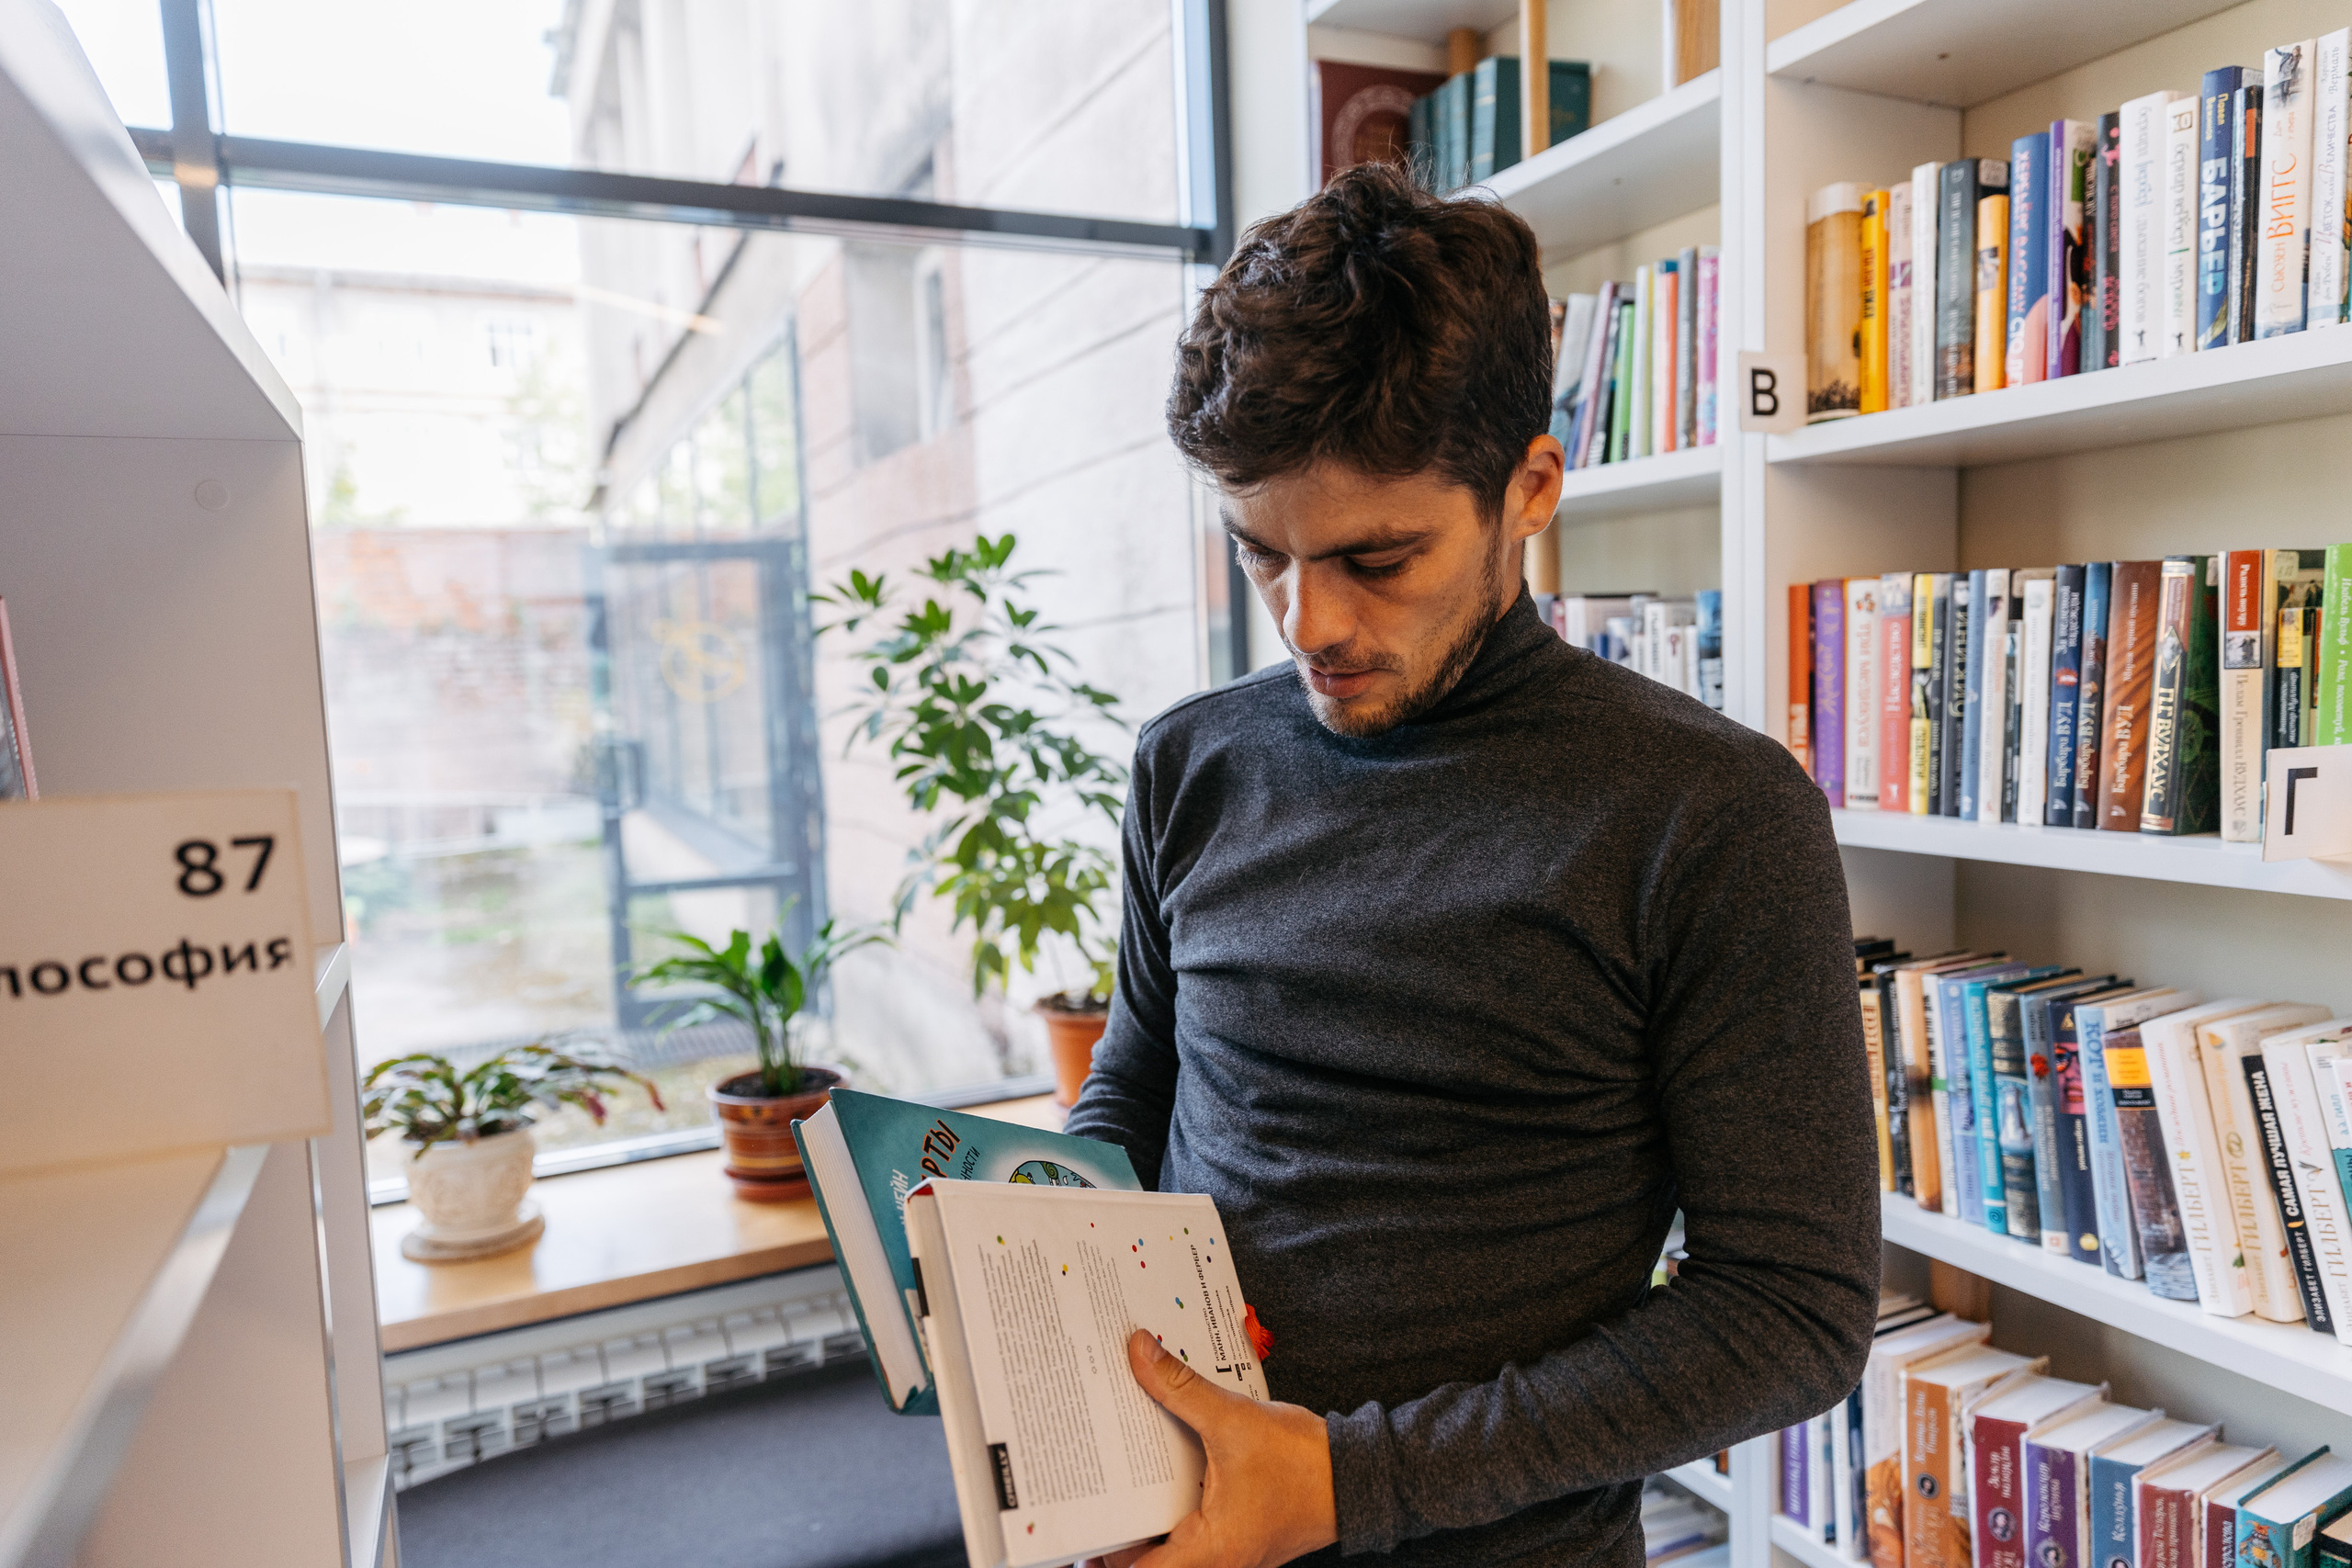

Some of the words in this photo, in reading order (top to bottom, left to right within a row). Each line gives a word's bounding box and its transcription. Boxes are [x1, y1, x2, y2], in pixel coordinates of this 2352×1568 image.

[2216, 94, 2228, 126] Павел
[2266, 152, 2297, 241] ВИГГС
[2199, 158, 2228, 296] БАРЬЕР
[2009, 317, 2026, 357] СТО
[2240, 564, 2251, 598] Радость
[2340, 578, 2351, 615] Изабель
[2236, 599, 2247, 627] поутру
[2337, 617, 2350, 645] Вульф
[2235, 674, 2249, 707] Пелам
[2336, 660, 2348, 682] Роза,
[2056, 701, 2073, 735] ВУД
[2078, 702, 2097, 736] ВУД
[2115, 705, 2134, 739] ВУД
[2054, 736, 2072, 787] Барбара
[2076, 738, 2095, 788] Барбара
[2111, 741, 2131, 793] Барбара
[2150, 718, 2174, 802] ВУДХАУС
[2233, 761, 2247, 817] ВУДХАУС
[173, 834, 277, 898] 87
[2085, 1021, 2104, 1070] КОТ
[2250, 1070, 2275, 1111] ЖЕНА
[921, 1118, 961, 1182] РТЫ
[2261, 1112, 2288, 1168] ЛУЧШАЯ
[2178, 1163, 2211, 1252] ГИЛБЕРТ
[2228, 1159, 2261, 1251] ГИЛБЕРТ
[2276, 1168, 2300, 1217] САМАЯ
[2293, 1231, 2314, 1272] ГИЛБЕРТ
[2307, 1183, 2348, 1278] ГИЛБЕРТ
[1190, 1244, 1204, 1280] ФЕРБЕР
[1204, 1290, 1218, 1329] ИВАНОВ
[2303, 1272, 2326, 1322] ЭЛИЗАБЕТ
[1202, 1307, 1220, 1362] издательство
[1214, 1329, 1227, 1361] МАНН,
[1215, 1290, 1237, 1360] facebook.com/mifbooks
[1225, 1285, 1249, 1359] instagram.com/mifbooks
[1226, 1308, 1243, 1360] vk.com/mifbooks
[2111, 1483, 2128, 1541] Колдунья
[2222, 1520, 2235, 1568] оролева
